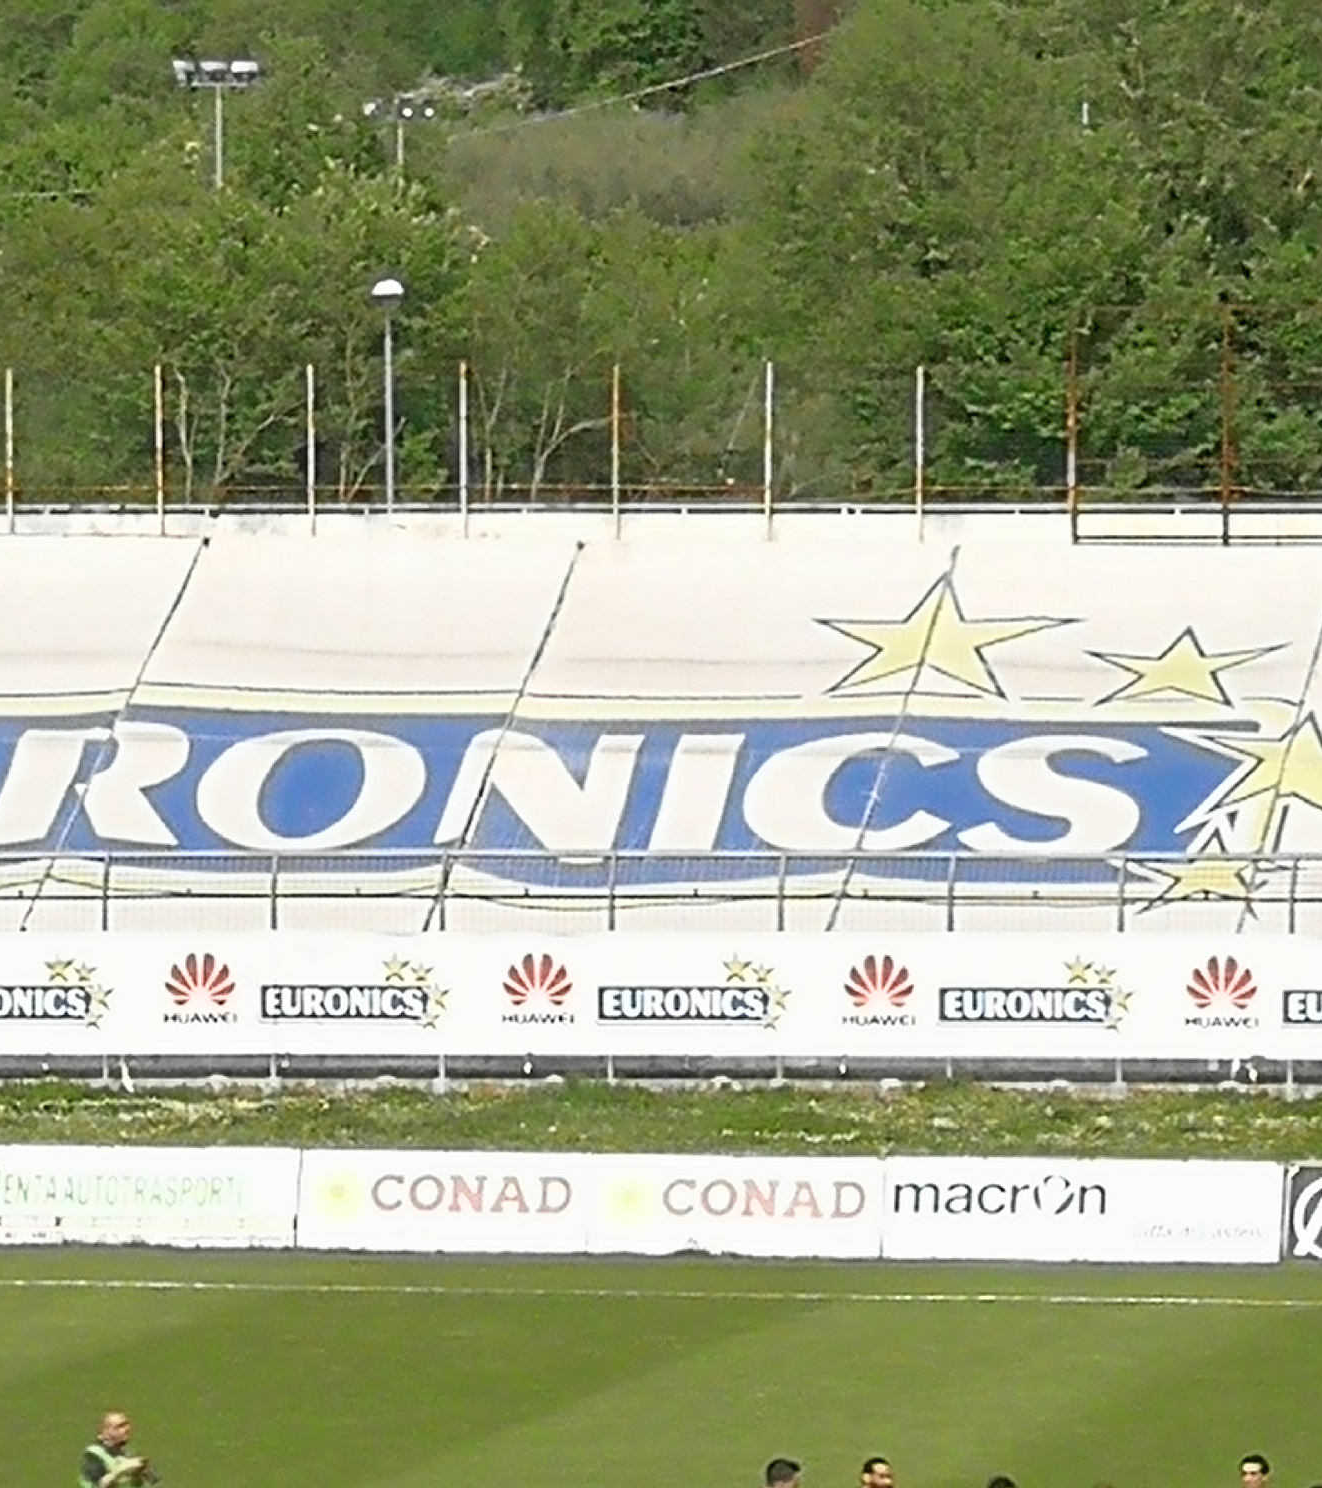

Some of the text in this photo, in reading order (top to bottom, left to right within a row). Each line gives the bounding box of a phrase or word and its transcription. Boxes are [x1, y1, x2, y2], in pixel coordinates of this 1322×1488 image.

[163, 1012, 239, 1024] HUAWEI
[264, 988, 423, 1019] EURONICS
[502, 1013, 576, 1025] HUAWEI
[602, 989, 765, 1020] EURONICS
[944, 990, 1107, 1021] EURONICS
[842, 1015, 917, 1027] HUAWEI
[1185, 1016, 1260, 1029] HUAWEI
[372, 1175, 572, 1213] CONAD
[662, 1179, 866, 1219] CONAD
